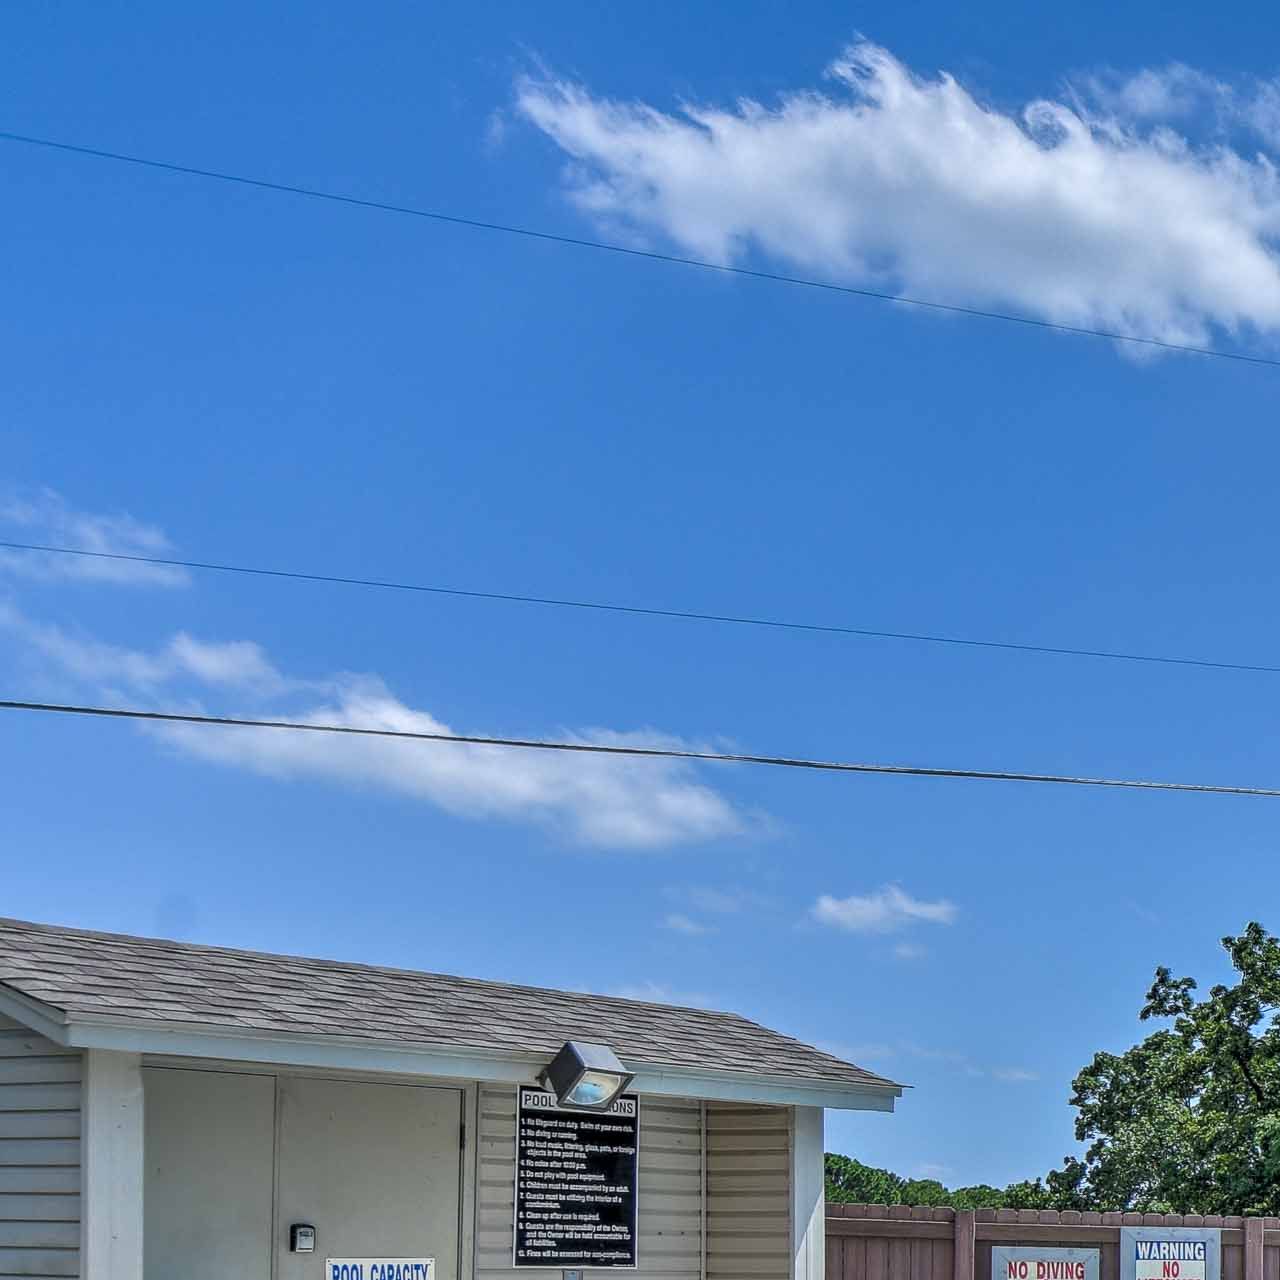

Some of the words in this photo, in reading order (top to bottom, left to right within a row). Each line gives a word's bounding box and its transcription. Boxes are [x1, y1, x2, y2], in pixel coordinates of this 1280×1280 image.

[525, 1095, 554, 1107] POOL
[1137, 1242, 1204, 1259] WARNING
[1008, 1261, 1028, 1279] NO
[1037, 1262, 1085, 1280] DIVING
[1163, 1261, 1179, 1278] NO
